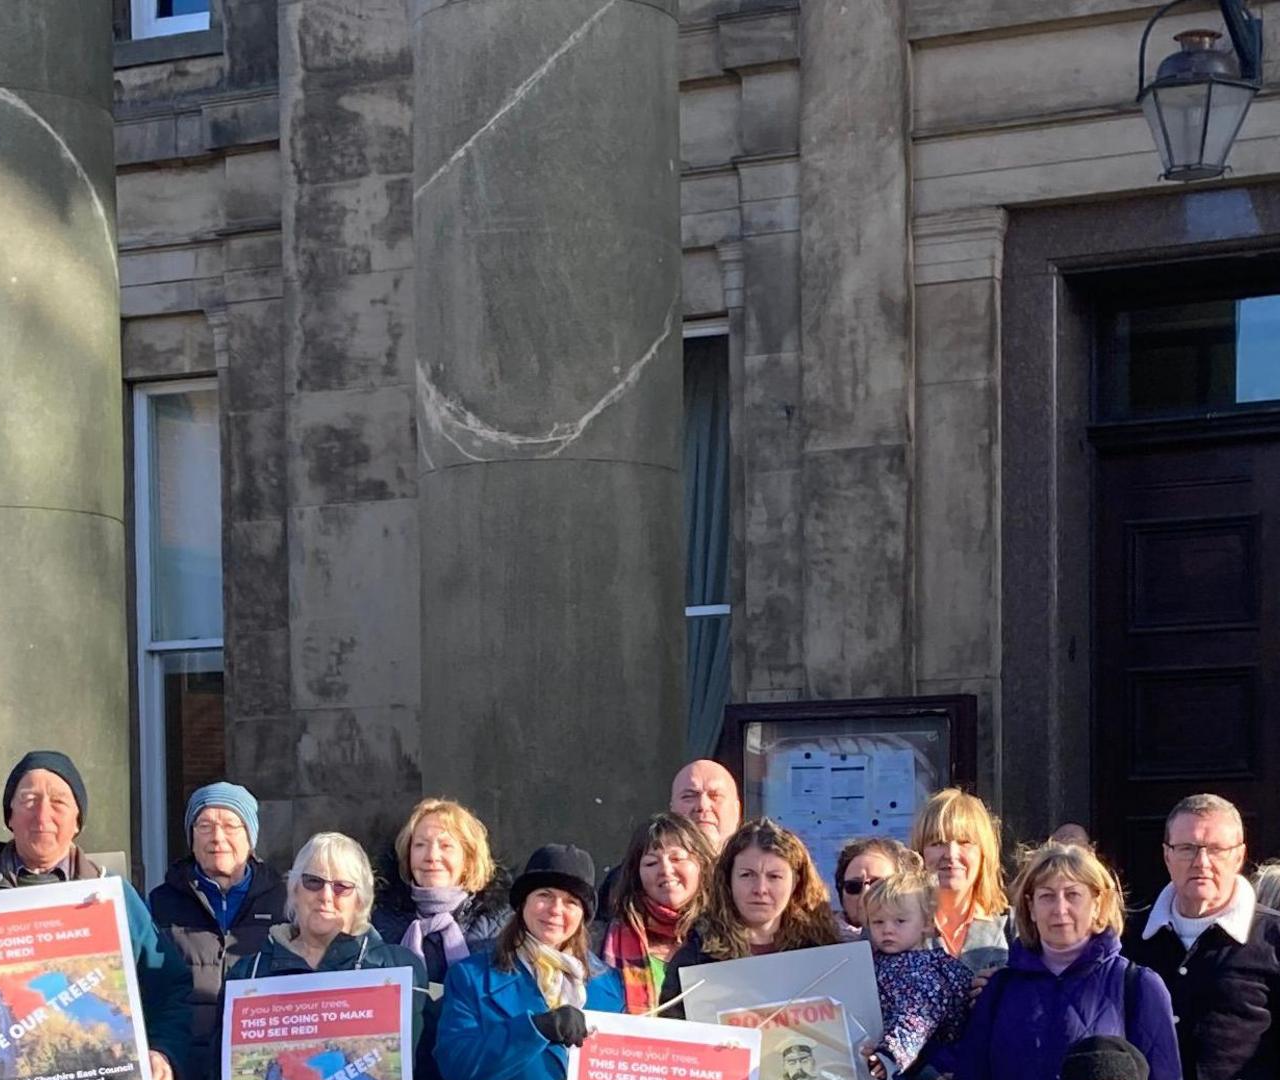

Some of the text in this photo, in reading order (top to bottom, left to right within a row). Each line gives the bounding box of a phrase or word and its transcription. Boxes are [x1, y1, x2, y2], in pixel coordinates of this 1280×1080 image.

[37, 933, 53, 943] TO
[56, 928, 91, 940] MAKE
[6, 948, 34, 959] RED!
[9, 1007, 49, 1039] OUR
[47, 968, 105, 1012] TREES!
[250, 1006, 270, 1016] you
[272, 1004, 292, 1013] love
[294, 1002, 319, 1012] your
[241, 1009, 374, 1028] THIS IS GOING TO MAKE
[241, 1025, 318, 1039] YOU SEE RED!
[77, 1069, 96, 1079] East
[99, 1064, 133, 1076] Council
[588, 1071, 612, 1080] YOU
[589, 1058, 723, 1080] THIS IS GOING TO MAKE
